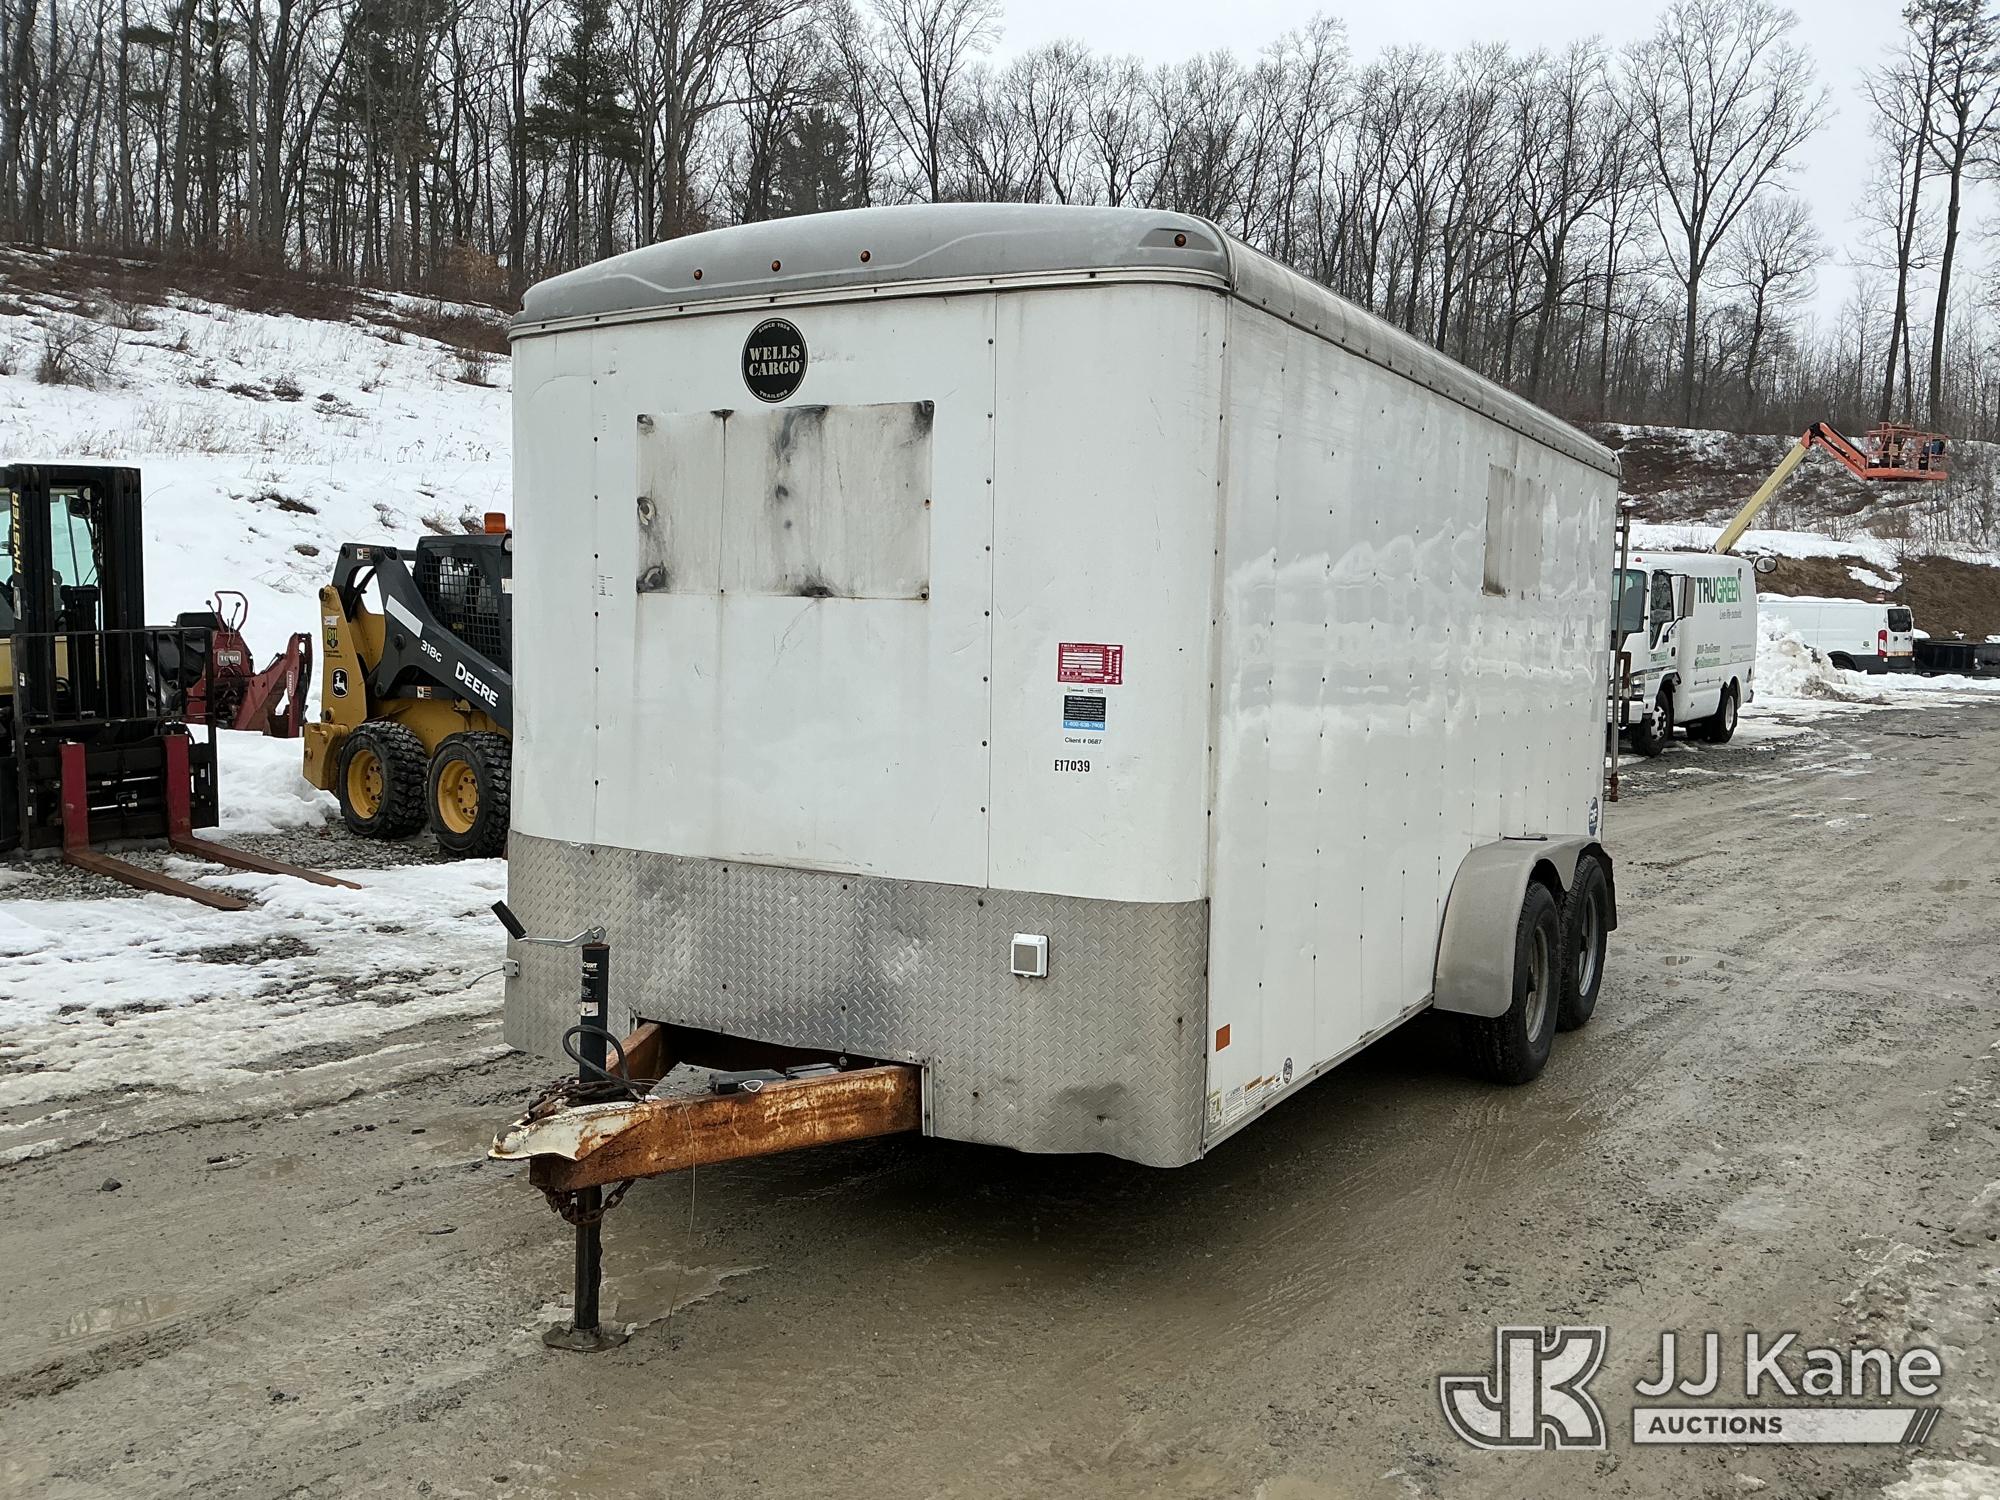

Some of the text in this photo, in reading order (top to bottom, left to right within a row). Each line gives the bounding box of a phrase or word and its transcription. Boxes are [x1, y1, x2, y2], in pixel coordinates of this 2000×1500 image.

[749, 344, 800, 361] WELLS
[748, 360, 800, 377] CARGO
[759, 389, 788, 399] TRAILERS
[12, 492, 22, 574] HYSTER
[1697, 576, 1741, 604] TRUGREEN
[420, 639, 443, 663] 318G
[455, 661, 499, 708] DEERE
[1054, 759, 1091, 773] E17039
